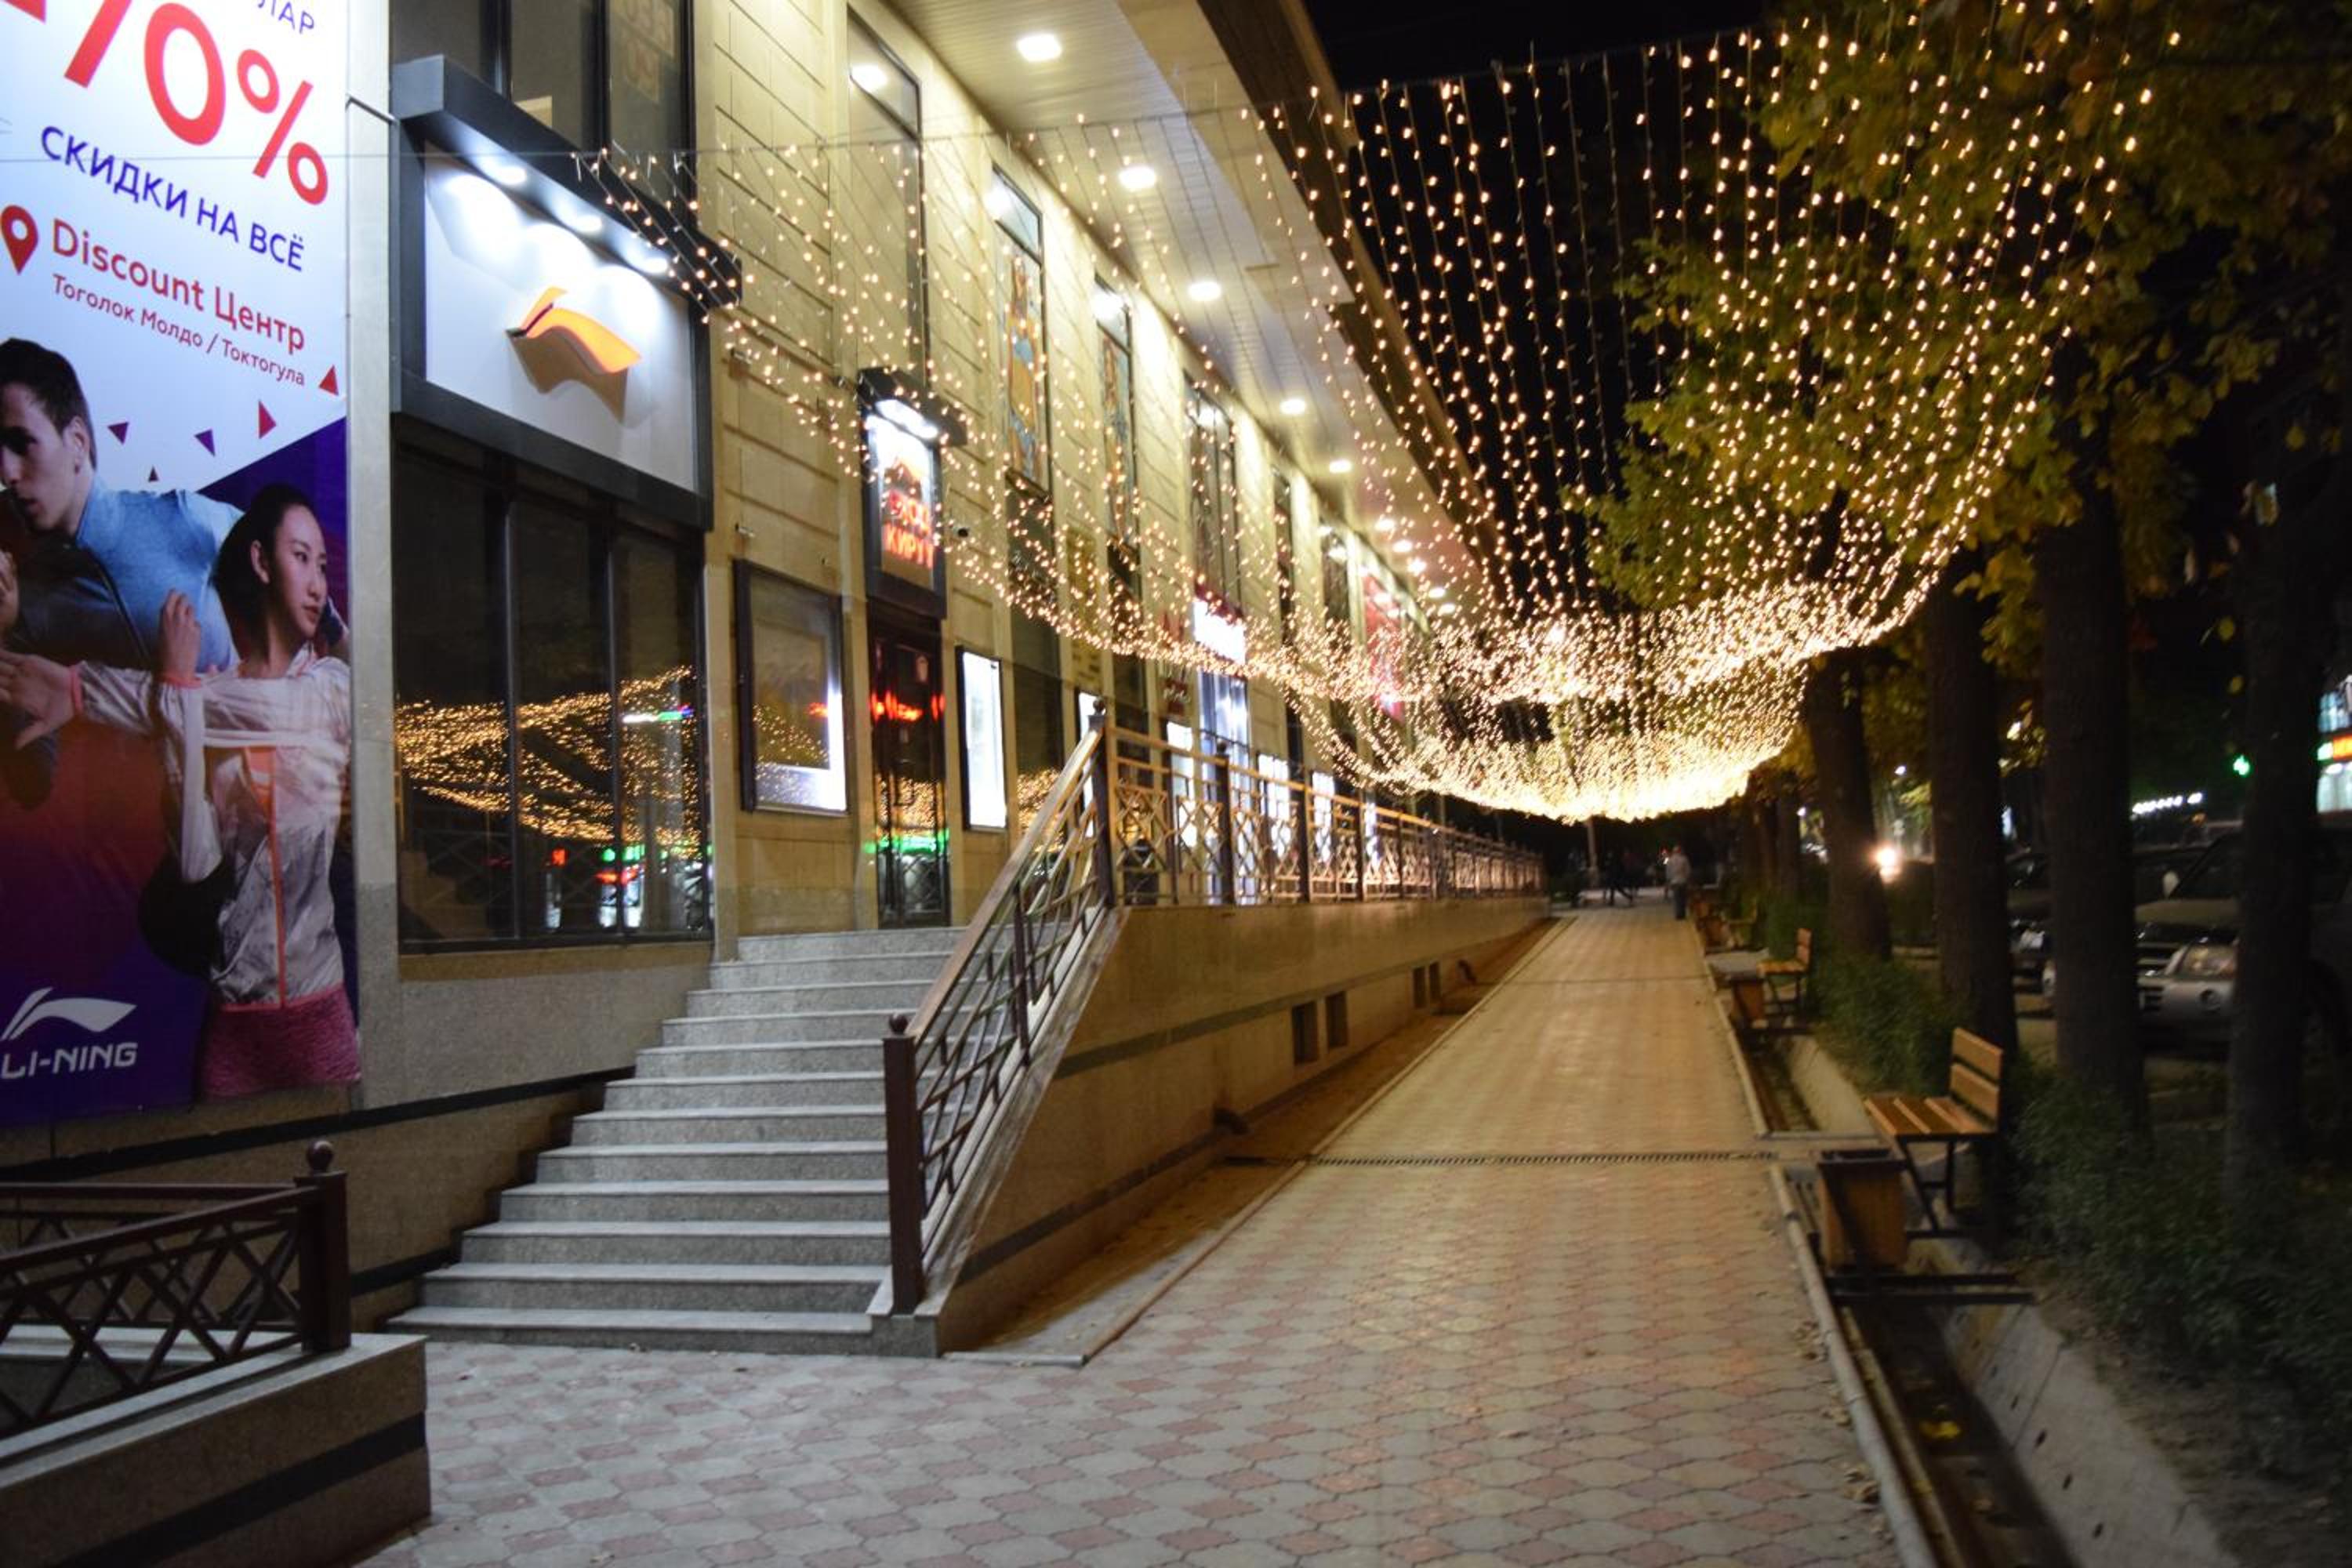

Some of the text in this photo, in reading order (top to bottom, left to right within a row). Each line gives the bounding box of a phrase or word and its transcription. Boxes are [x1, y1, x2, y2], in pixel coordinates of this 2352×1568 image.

[41, 126, 305, 272] СКИДКИ НА ВСЁ
[52, 274, 135, 322] Тоголок
[141, 308, 203, 349] Молдо
[222, 339, 305, 386] Токтогула
[53, 218, 305, 354] Discount Центр
[1, 1042, 138, 1080] LI-NING
